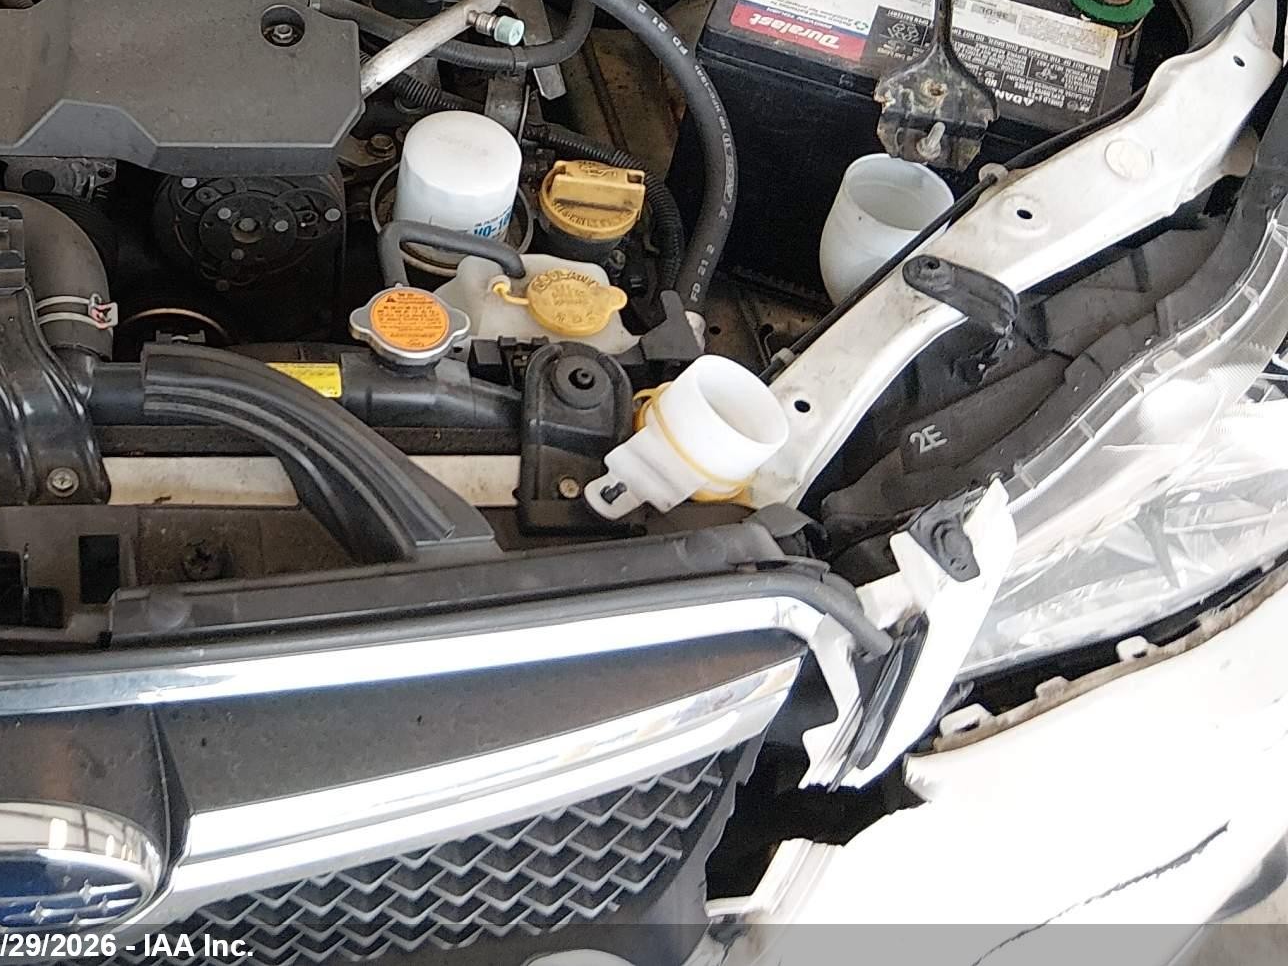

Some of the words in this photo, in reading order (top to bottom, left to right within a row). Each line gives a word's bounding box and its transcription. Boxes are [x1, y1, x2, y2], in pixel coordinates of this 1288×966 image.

[748, 12, 840, 48] Duralast
[689, 282, 701, 303] FD
[697, 259, 709, 276] 21
[909, 424, 948, 454] 2E
